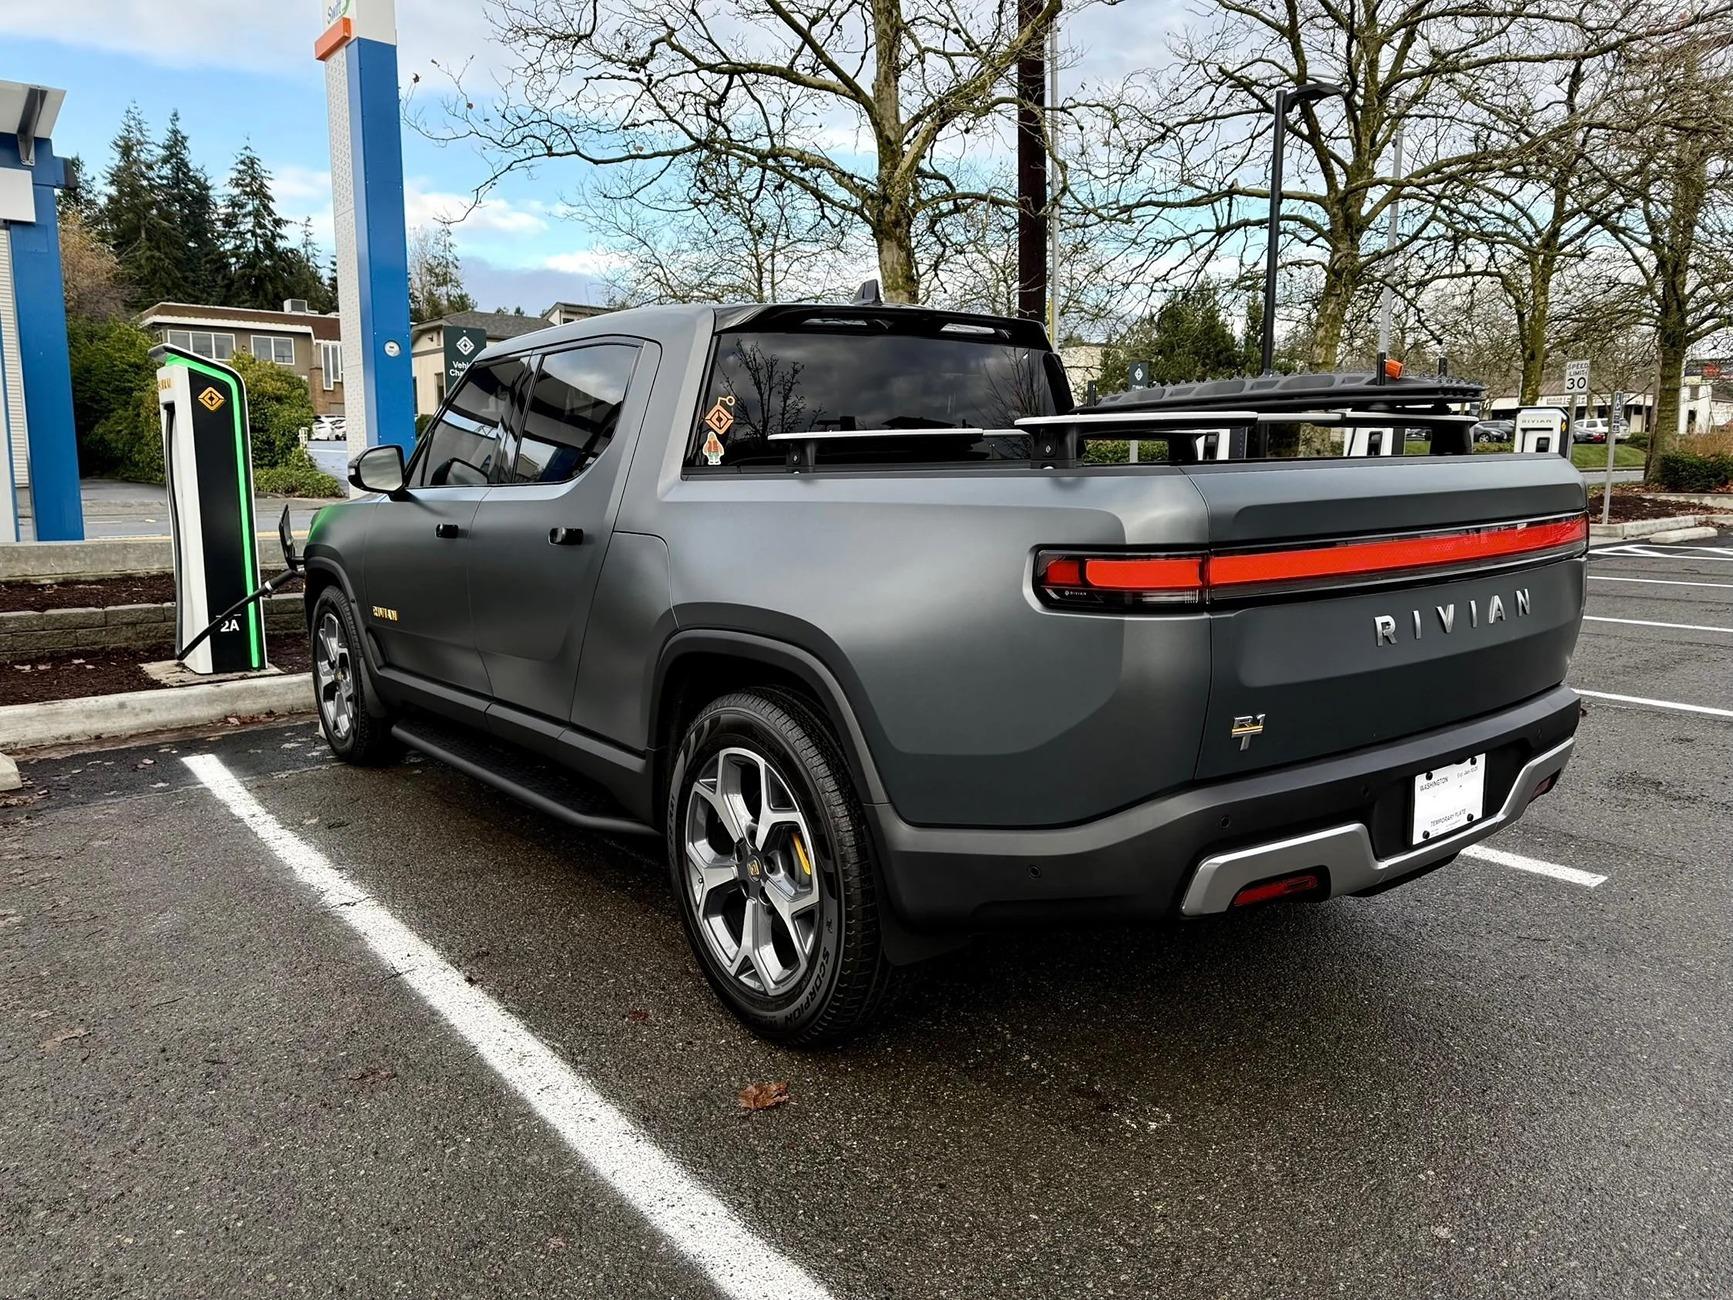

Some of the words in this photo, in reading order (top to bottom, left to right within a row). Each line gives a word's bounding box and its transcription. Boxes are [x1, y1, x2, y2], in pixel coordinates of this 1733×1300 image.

[1567, 362, 1590, 370] SPEED
[1569, 369, 1588, 377] LIMIT
[1566, 376, 1587, 390] 30
[1374, 588, 1532, 647] RIVIAN
[220, 619, 240, 632] 2A
[1419, 776, 1449, 792] WASHINGTON
[784, 946, 830, 1025] SCORPION
